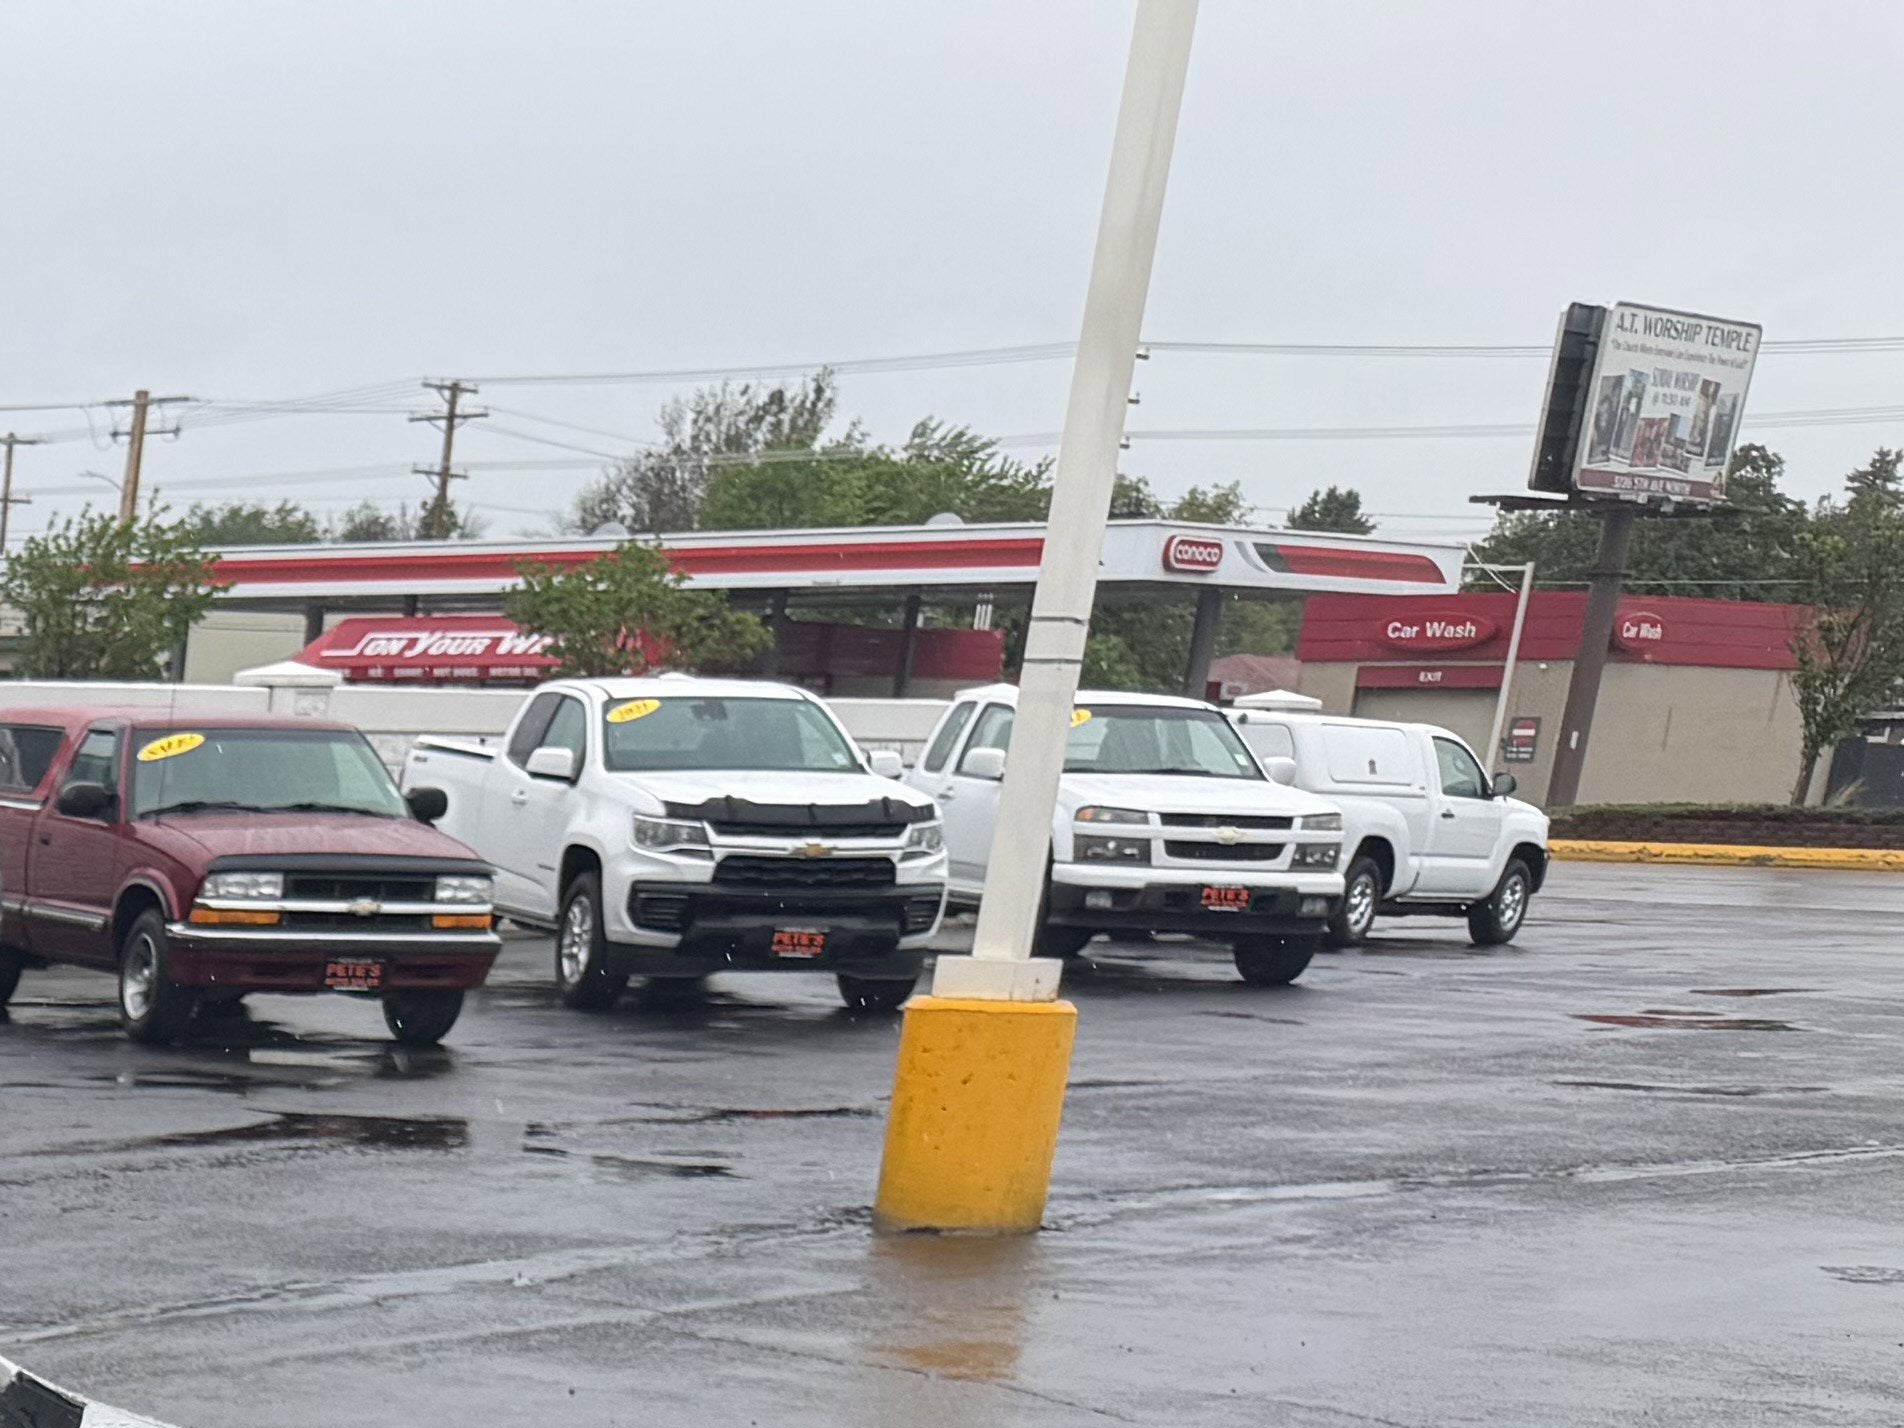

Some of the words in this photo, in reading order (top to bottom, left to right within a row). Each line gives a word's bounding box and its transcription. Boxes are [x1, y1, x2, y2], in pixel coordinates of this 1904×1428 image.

[1642, 315, 1704, 343] WORSHIP
[1705, 324, 1755, 353] TEMPLE
[1387, 621, 1419, 638] Car
[1425, 620, 1477, 638] Wash
[1622, 621, 1637, 638] Car
[1639, 621, 1663, 640] Wash
